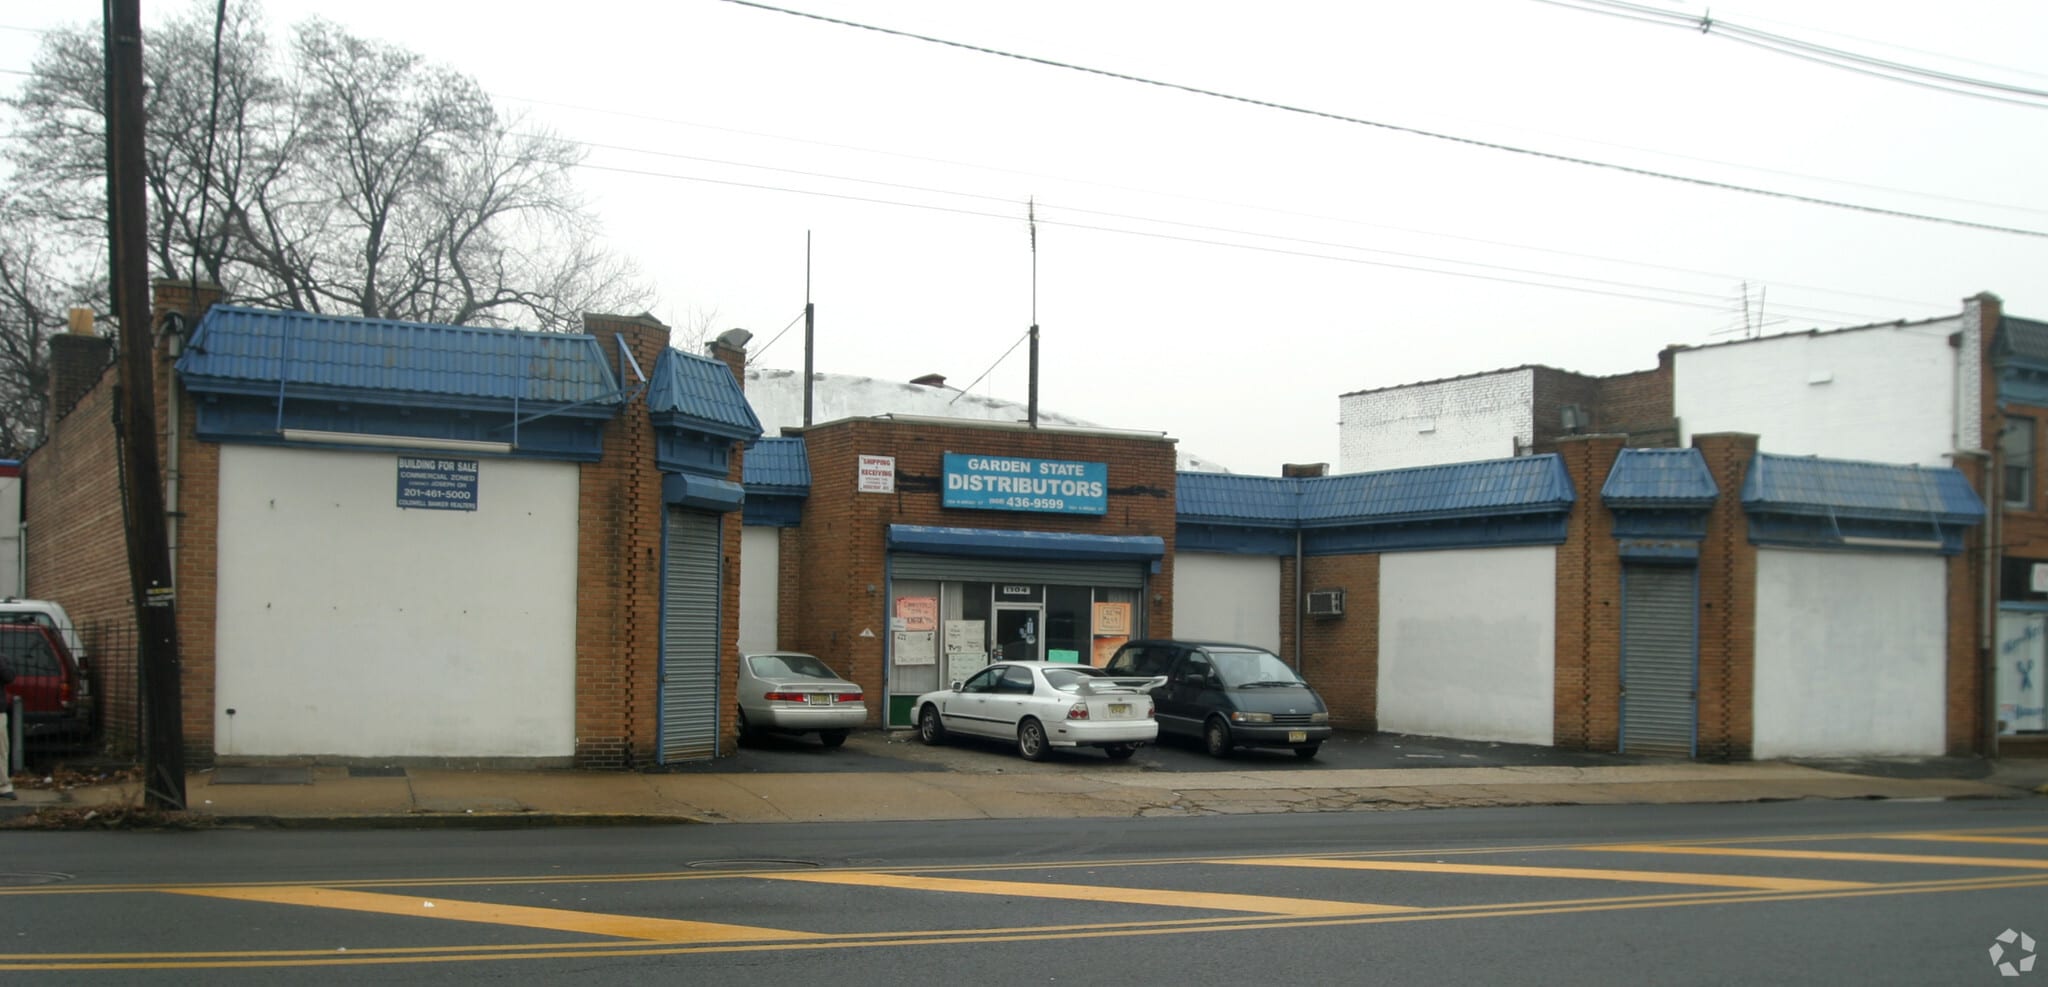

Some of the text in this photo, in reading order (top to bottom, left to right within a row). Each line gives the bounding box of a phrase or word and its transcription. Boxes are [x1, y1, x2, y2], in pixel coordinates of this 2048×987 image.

[399, 459, 477, 472] BUILDING FOR SALE
[863, 458, 891, 466] SHIPPING
[967, 458, 1085, 476] GARDEN STATE
[400, 471, 448, 480] COMMERCIAL
[861, 469, 892, 477] RECEIVING
[948, 472, 1103, 498] DISTRIBUTORS
[404, 488, 471, 499] 201-461-5000
[1006, 496, 1064, 510] 436-9599
